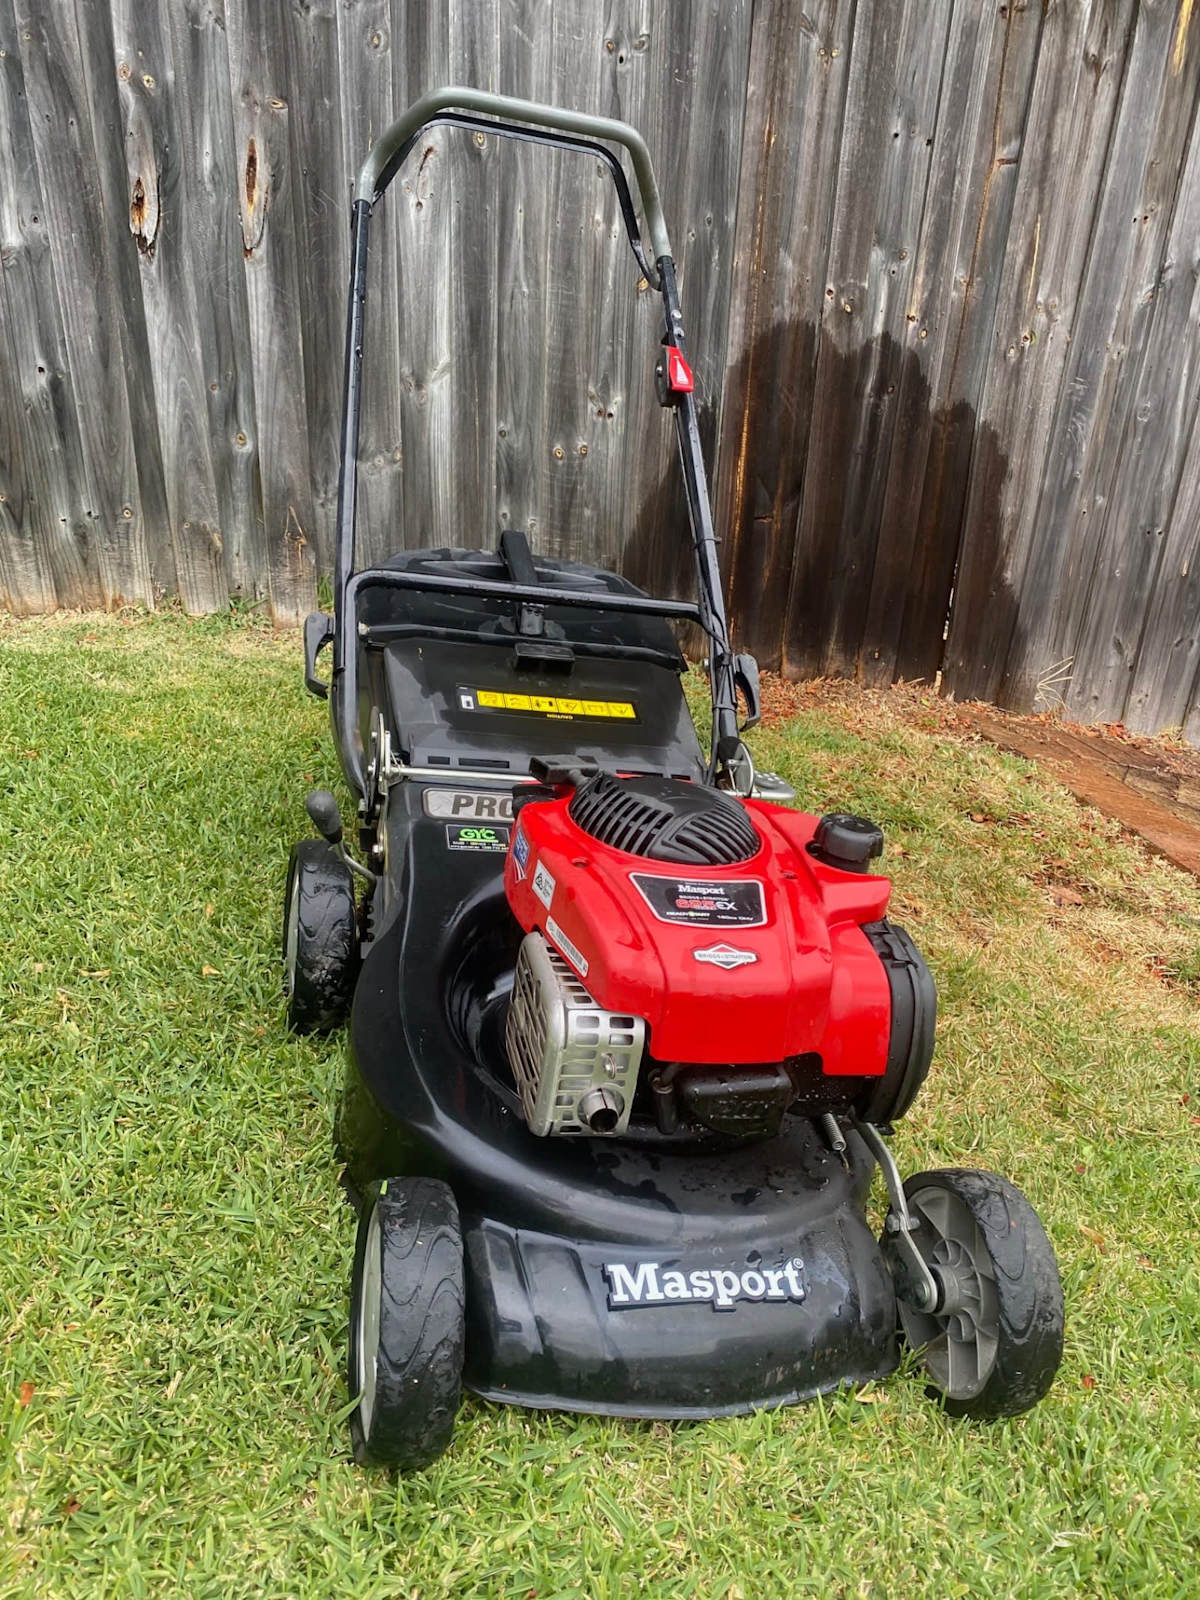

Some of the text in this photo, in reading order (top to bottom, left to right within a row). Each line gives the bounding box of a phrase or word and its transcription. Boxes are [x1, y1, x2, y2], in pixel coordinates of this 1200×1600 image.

[451, 794, 514, 818] PRO
[459, 828, 496, 840] GYC
[677, 884, 725, 895] Masport
[607, 1261, 805, 1306] Masport
